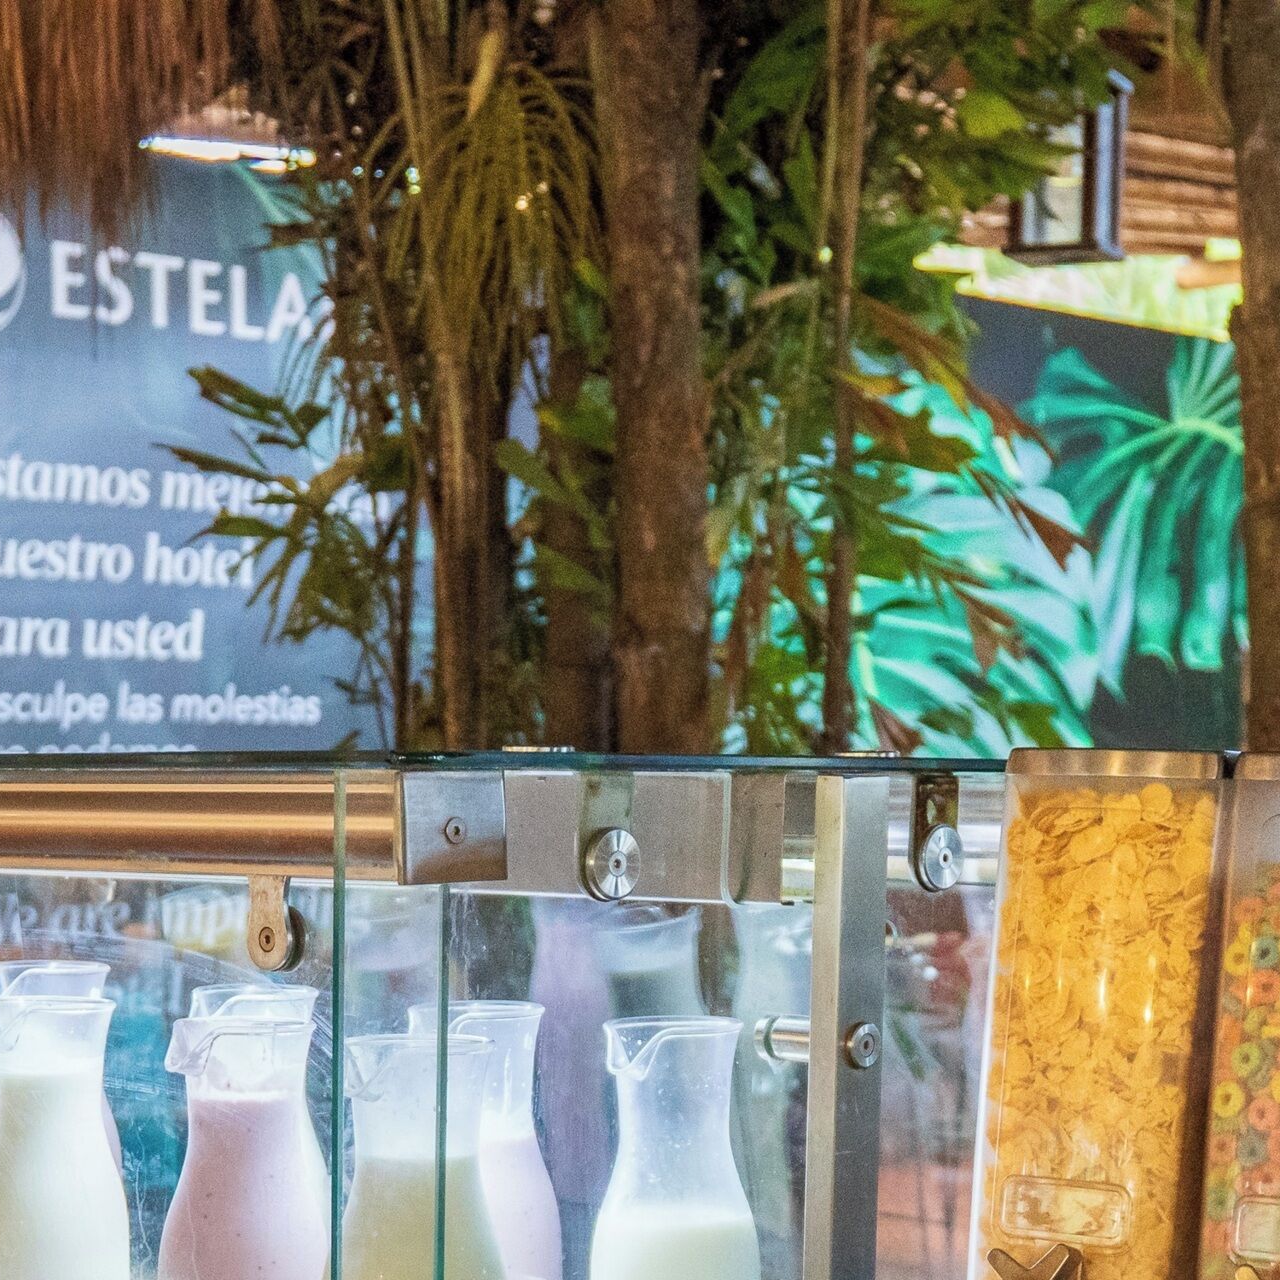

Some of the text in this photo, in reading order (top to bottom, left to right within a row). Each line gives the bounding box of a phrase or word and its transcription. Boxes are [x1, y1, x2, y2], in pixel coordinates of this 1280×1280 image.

[82, 607, 205, 662] usted
[118, 681, 164, 724] las
[170, 684, 322, 728] molestias
